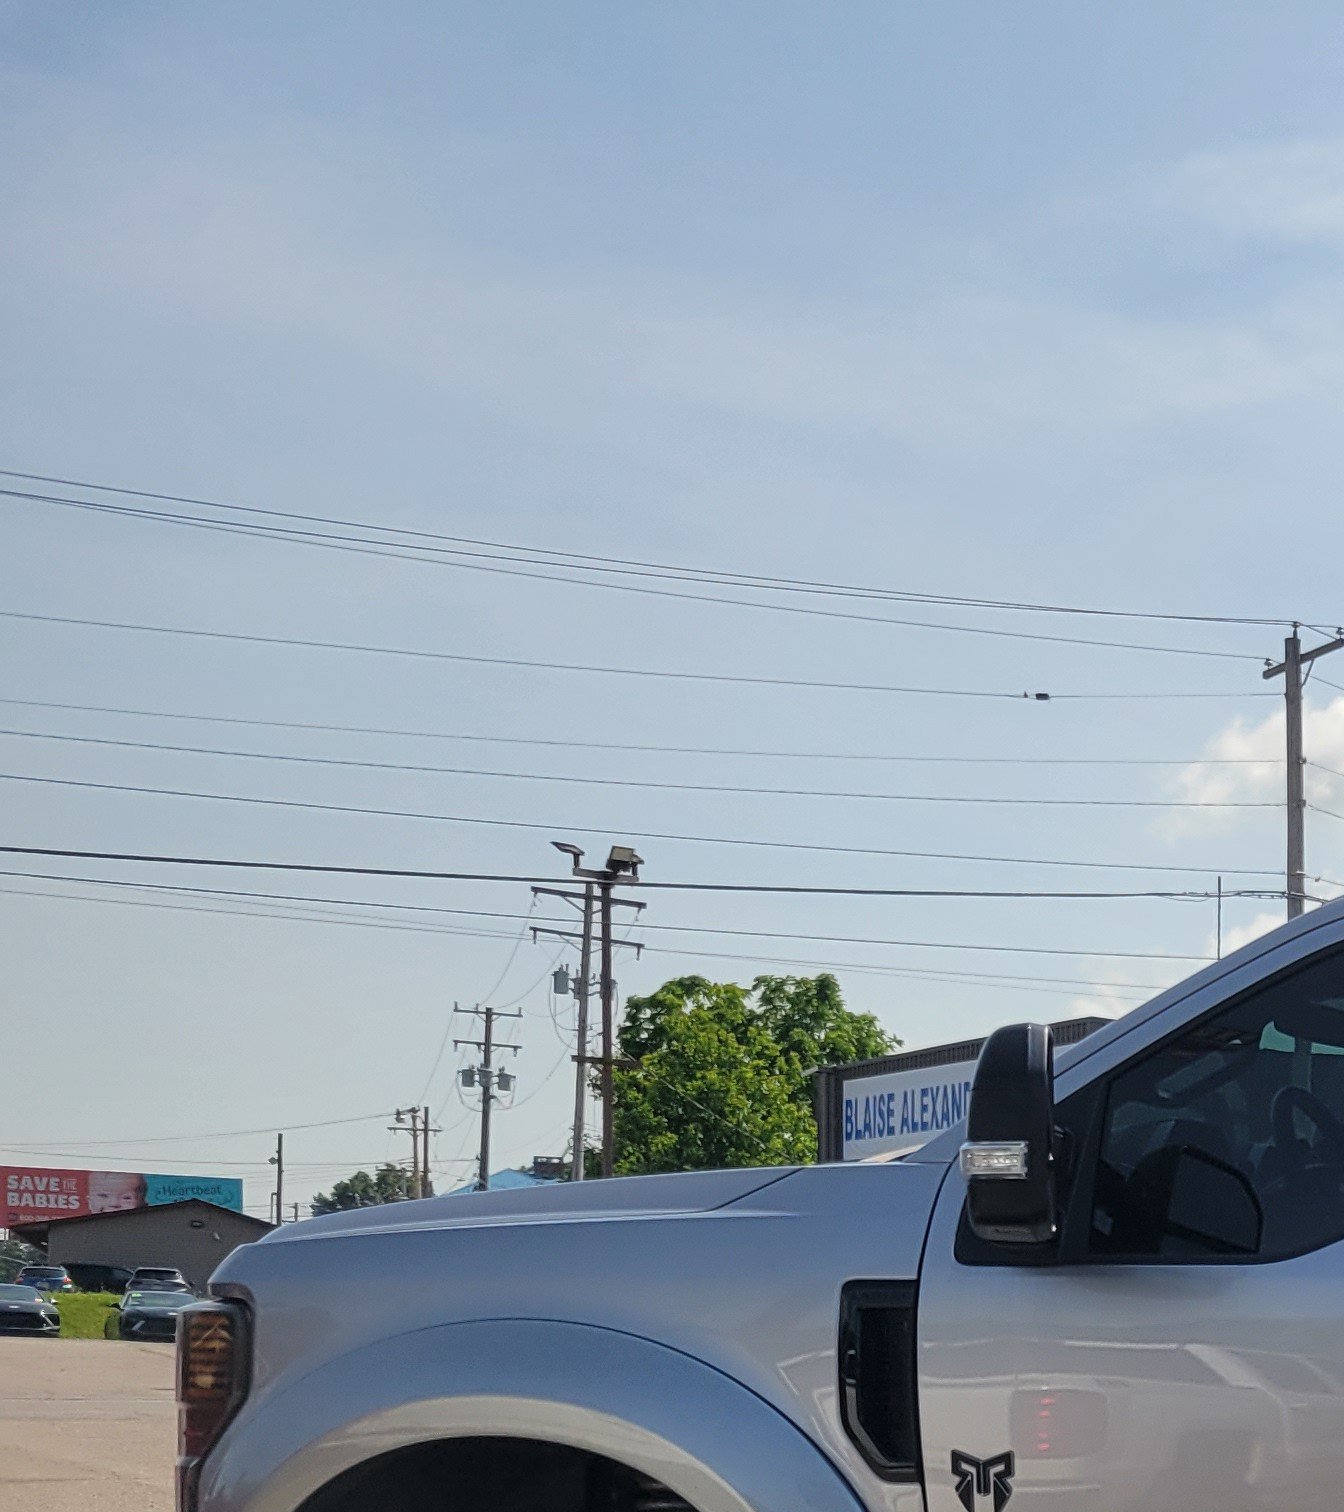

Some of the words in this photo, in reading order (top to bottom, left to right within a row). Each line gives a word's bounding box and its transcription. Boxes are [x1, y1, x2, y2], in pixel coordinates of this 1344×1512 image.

[845, 1092, 895, 1141] BLAISE
[7, 1175, 60, 1192] SAVE
[162, 1185, 222, 1196] Heartbeat
[7, 1192, 80, 1209] BABIES
